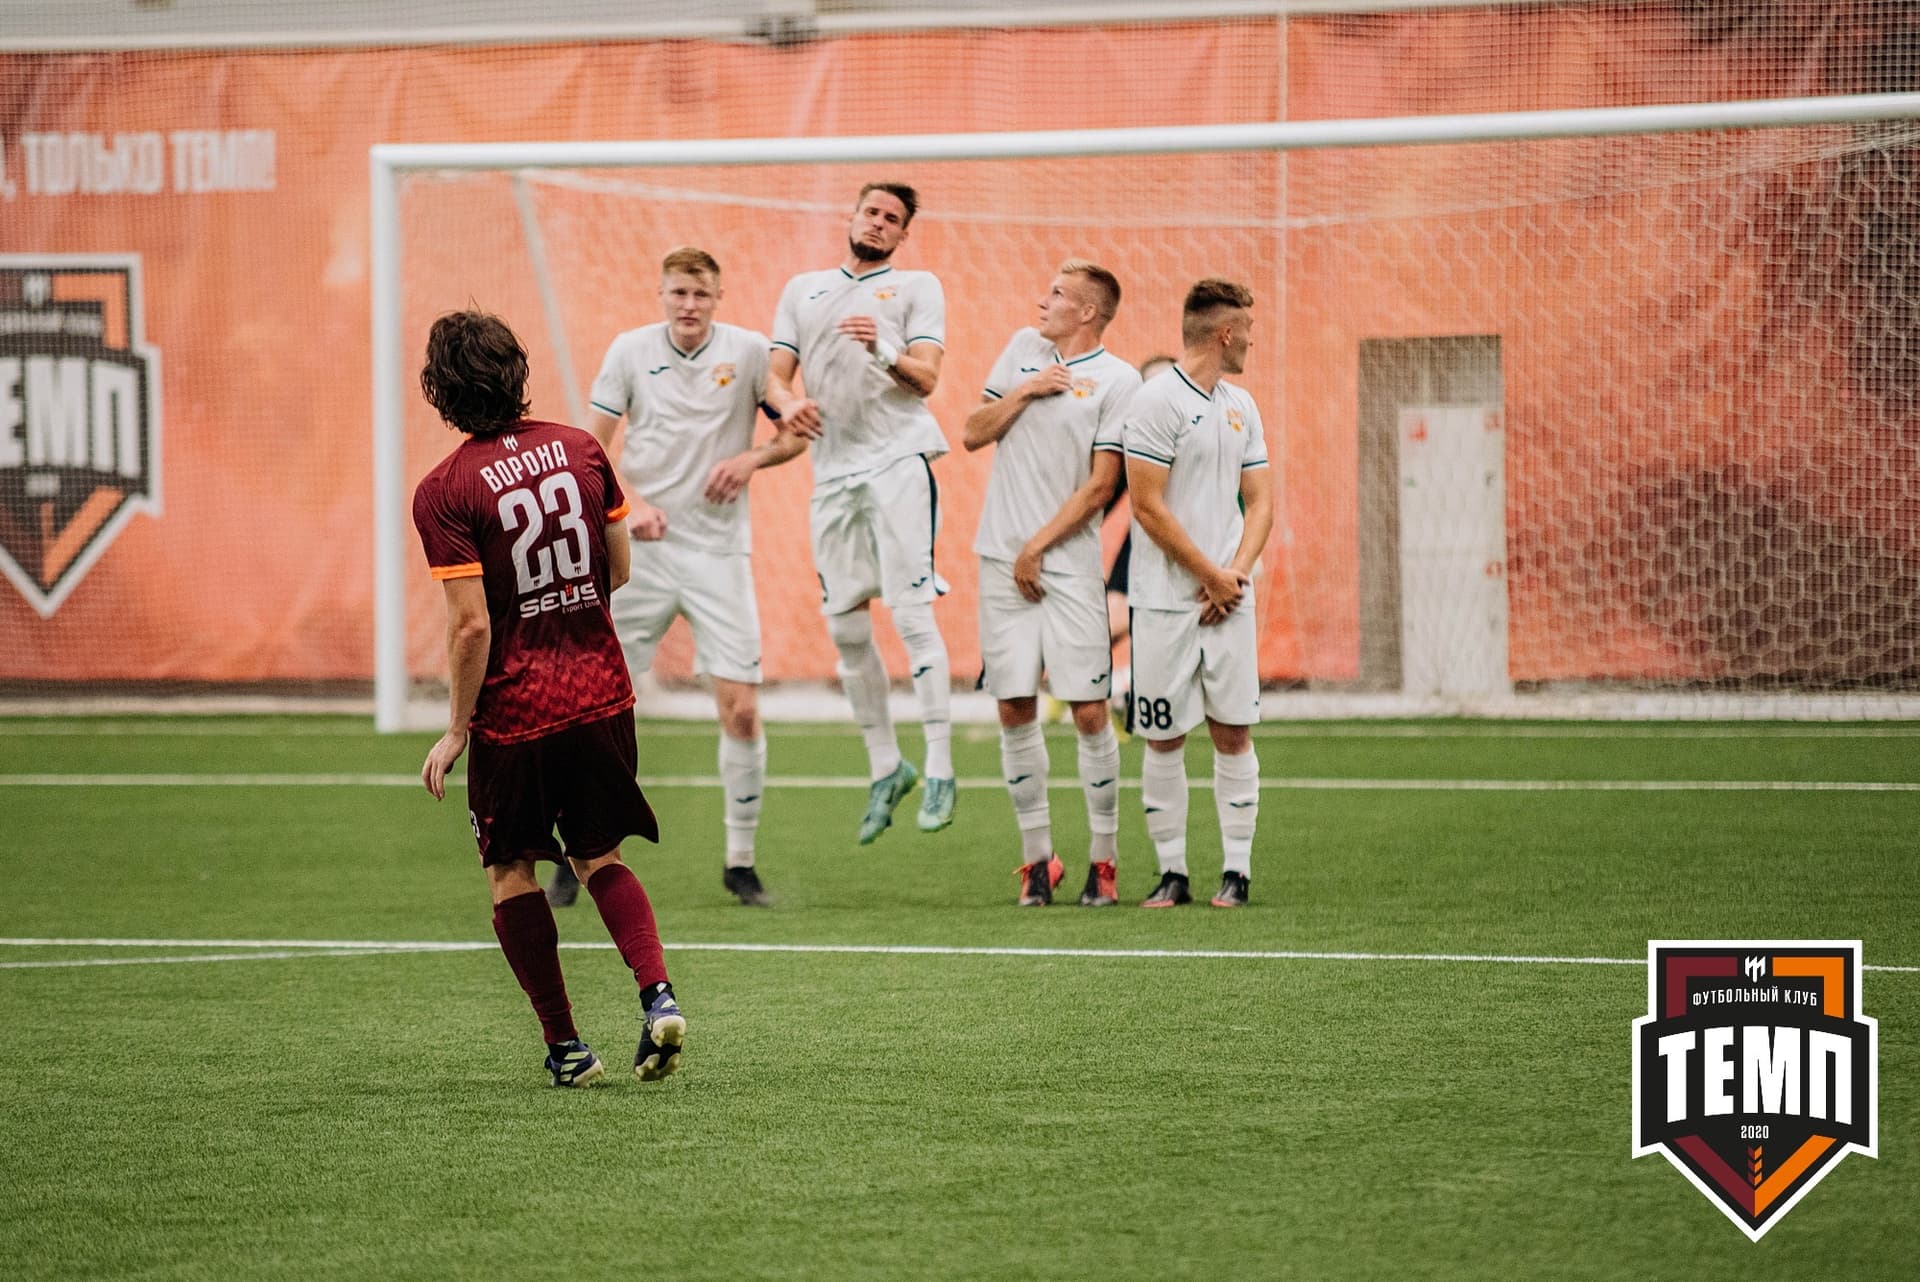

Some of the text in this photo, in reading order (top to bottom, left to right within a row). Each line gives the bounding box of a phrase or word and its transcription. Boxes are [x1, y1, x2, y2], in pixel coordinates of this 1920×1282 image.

[480, 440, 569, 494] ВОРОНА
[498, 471, 591, 595] 23
[1138, 696, 1173, 730] 98
